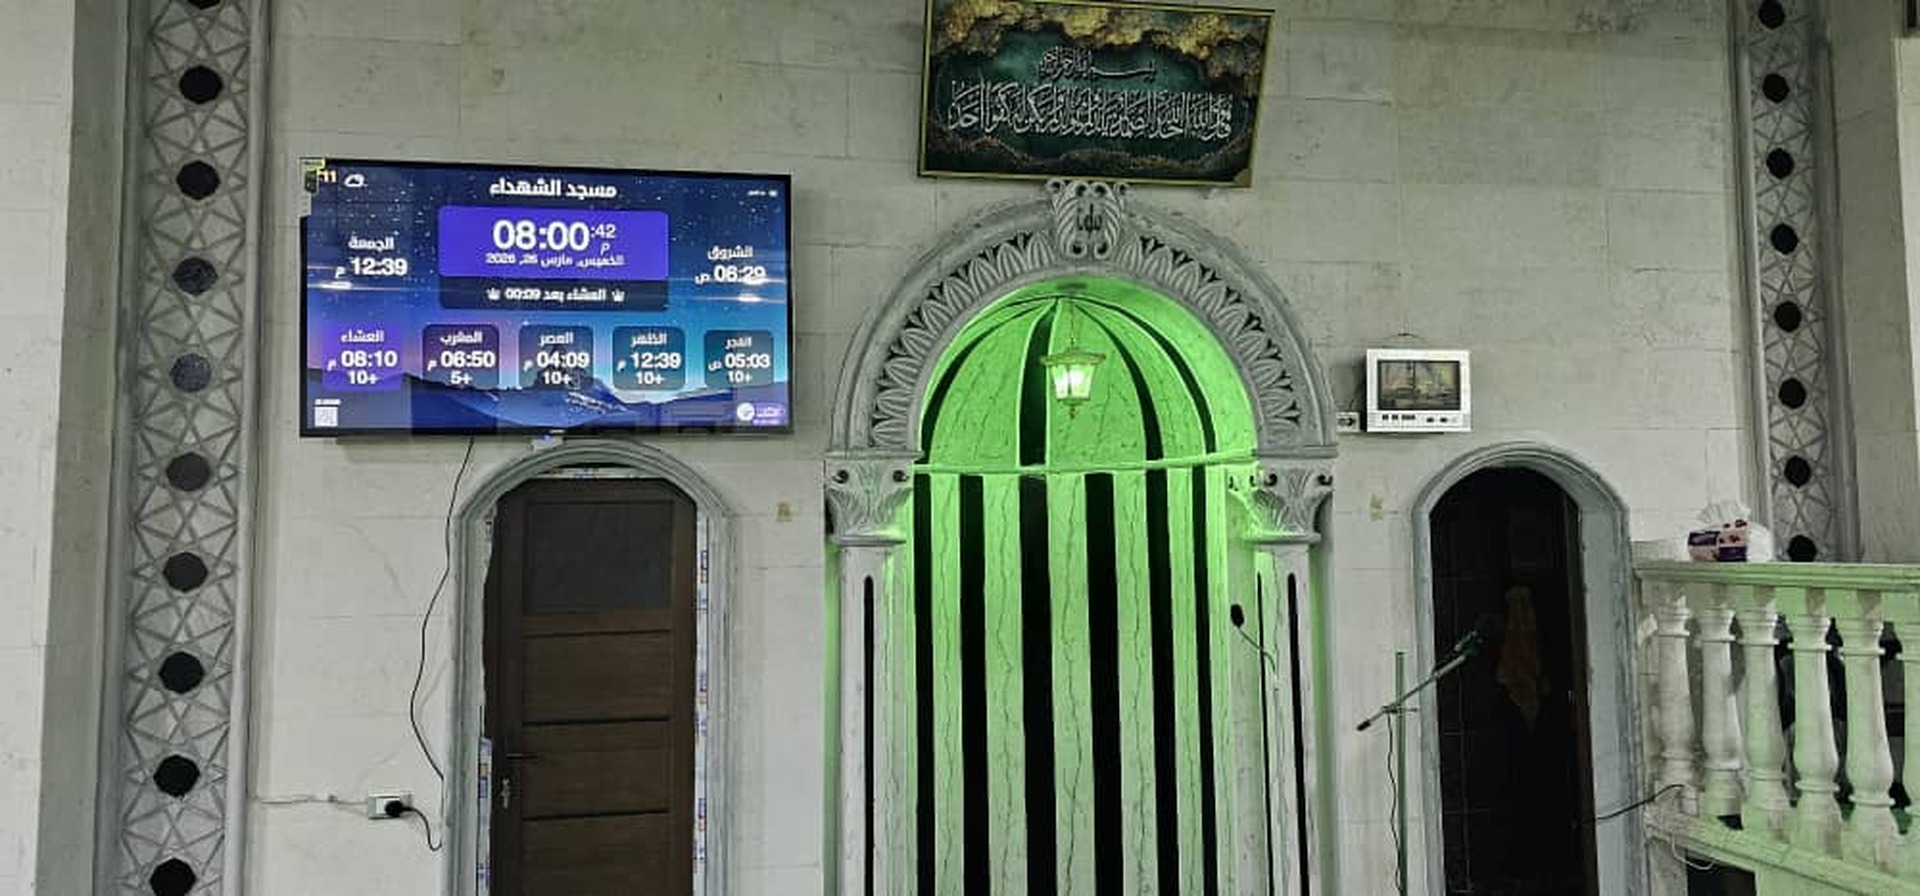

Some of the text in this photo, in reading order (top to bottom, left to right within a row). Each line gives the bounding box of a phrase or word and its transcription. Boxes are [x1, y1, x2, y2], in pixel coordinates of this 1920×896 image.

[489, 177, 617, 200] مسجد الشهداء
[348, 232, 395, 252] الجمعة
[493, 220, 590, 251] 08:00
[601, 243, 610, 256] م
[707, 245, 753, 260] الشروق
[485, 252, 516, 264] 2026
[540, 254, 573, 268] مارس
[335, 258, 408, 279] 12:39 م
[714, 264, 767, 284] 06:29
[504, 287, 606, 303] العشاء بعد 00:09
[341, 329, 385, 343] العشاء
[440, 330, 483, 346] المغرب
[539, 331, 574, 347] العصر
[631, 331, 667, 347] الظهر
[725, 336, 752, 350] الفجر
[341, 350, 398, 368] 08:10
[440, 350, 496, 368] 06:50
[537, 351, 590, 369] 04:09
[631, 352, 682, 369] 12:39
[725, 353, 771, 369] 05:03
